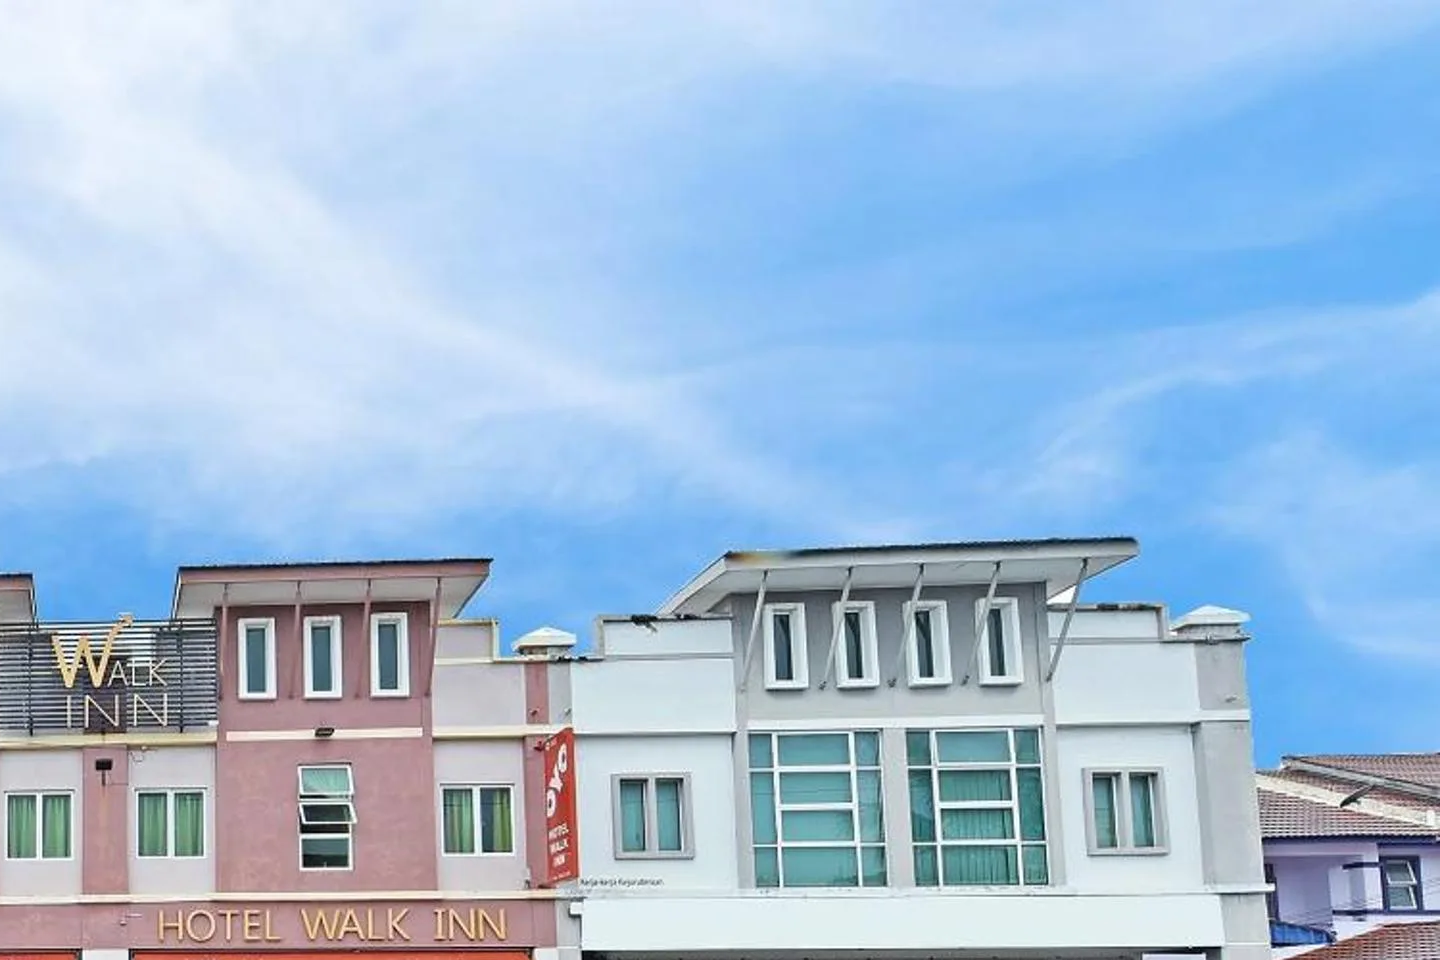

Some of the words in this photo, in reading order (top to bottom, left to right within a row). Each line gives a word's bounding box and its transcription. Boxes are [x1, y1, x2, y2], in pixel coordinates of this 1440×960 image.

[66, 693, 168, 729] INN
[158, 908, 282, 943] HOTEL
[300, 907, 411, 942] WALK
[433, 908, 507, 942] INN
